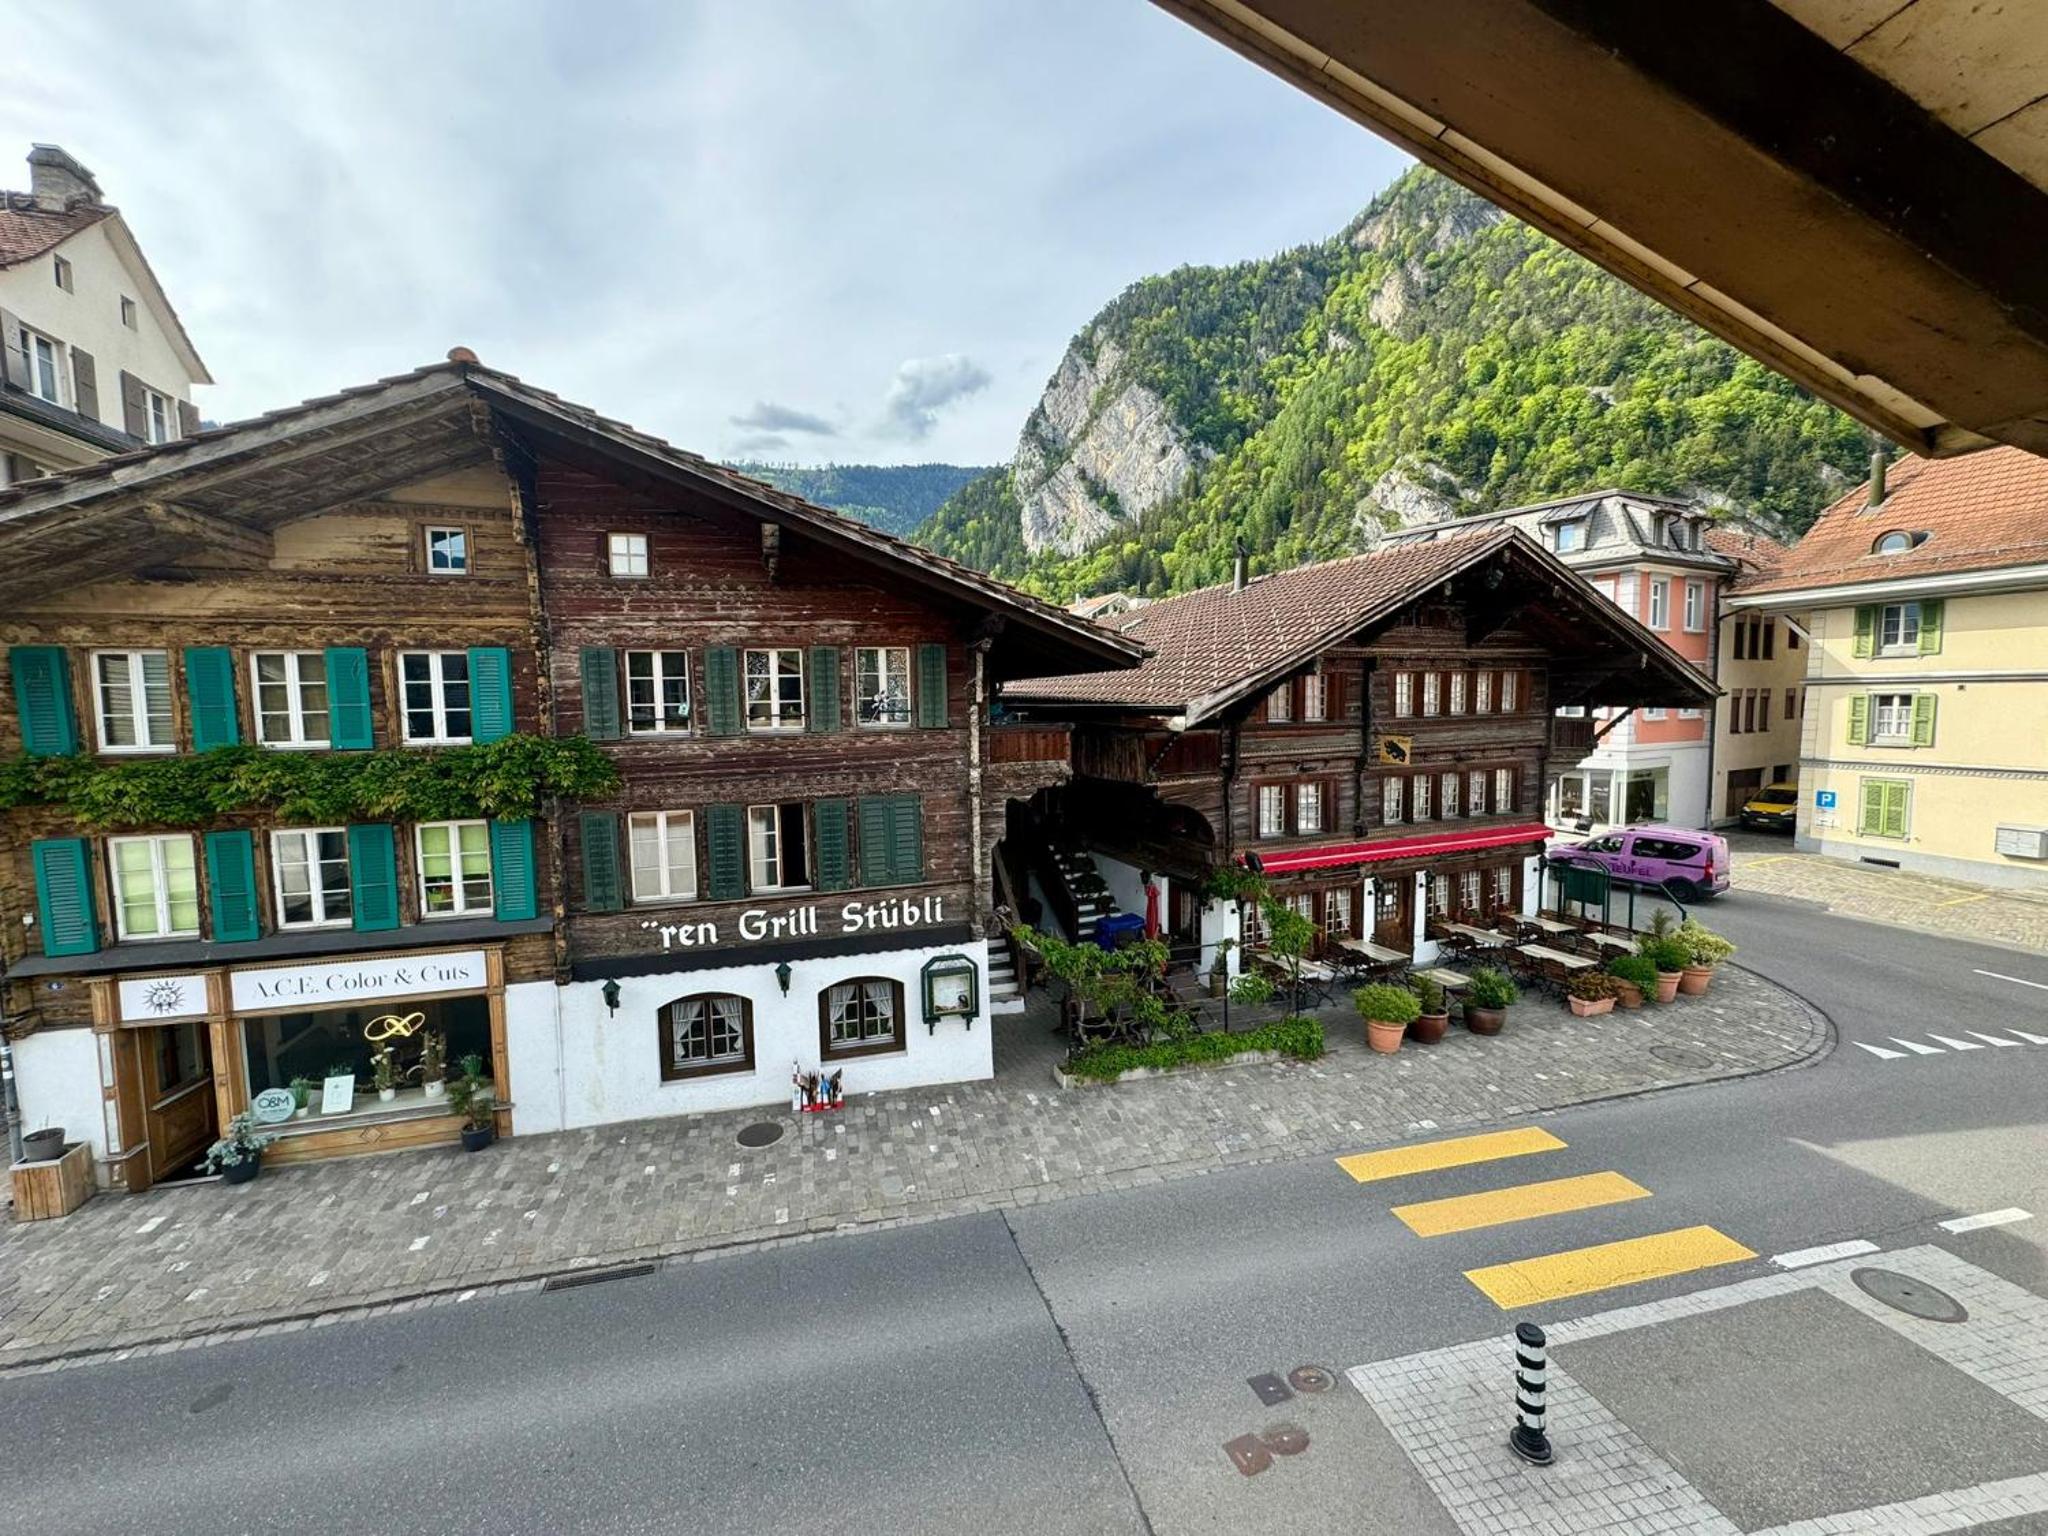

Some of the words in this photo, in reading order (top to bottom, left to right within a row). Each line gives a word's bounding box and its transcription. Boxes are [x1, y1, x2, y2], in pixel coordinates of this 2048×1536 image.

[1821, 794, 1833, 806] P
[737, 905, 819, 941] Grill
[841, 896, 944, 933] Stübli
[252, 975, 319, 999] A.C.E.
[326, 971, 387, 993] Color
[394, 967, 413, 985] &
[420, 964, 470, 981] Cuts
